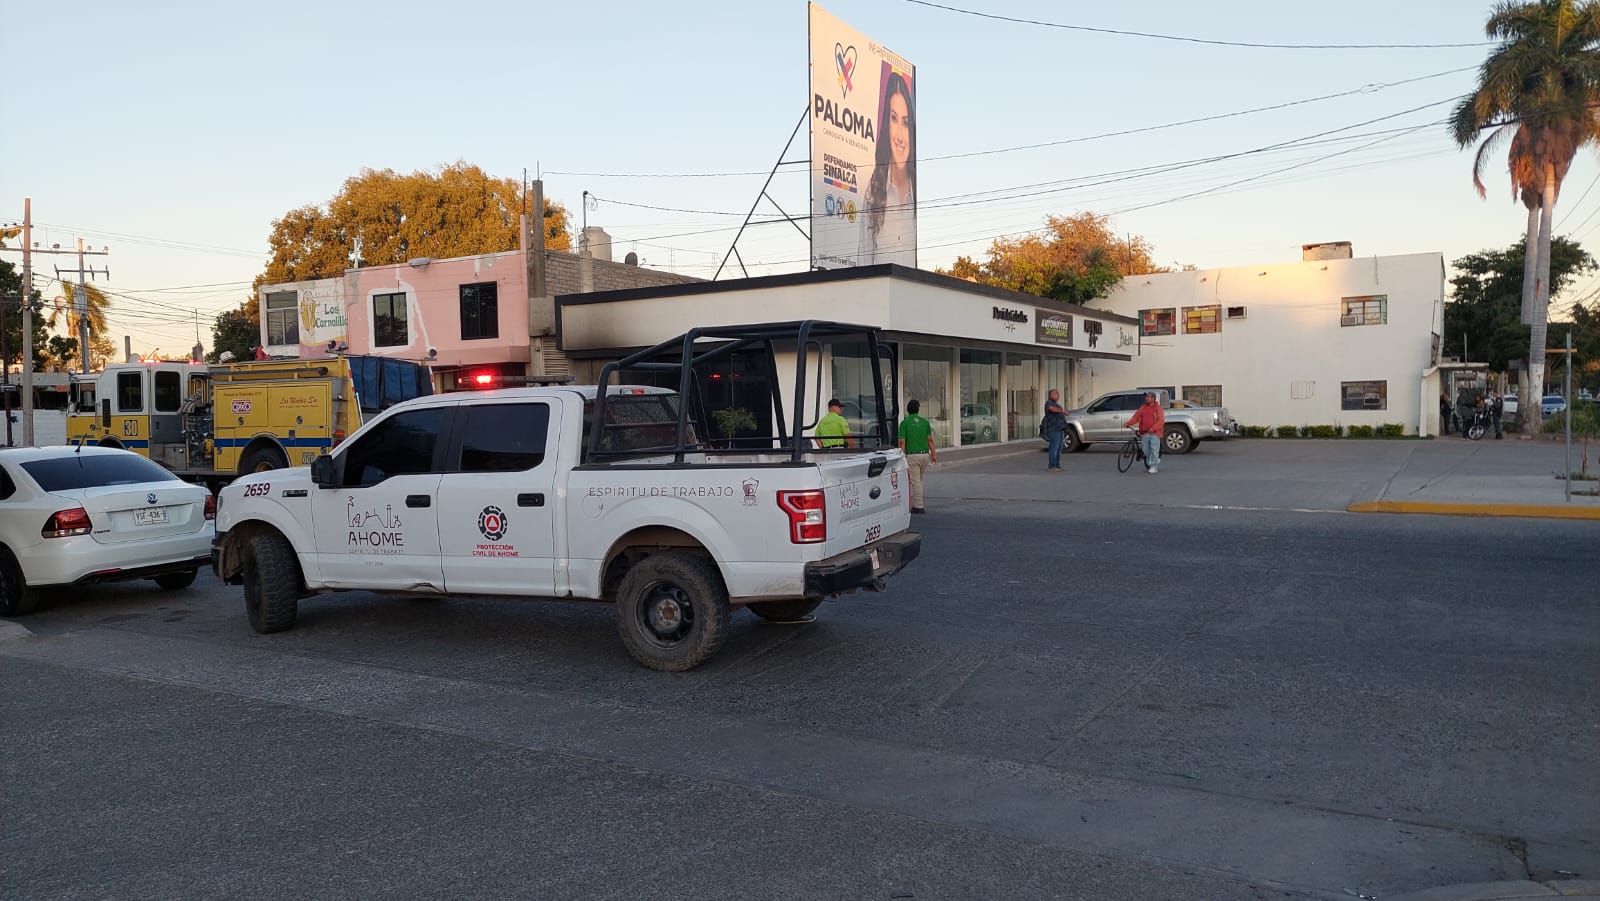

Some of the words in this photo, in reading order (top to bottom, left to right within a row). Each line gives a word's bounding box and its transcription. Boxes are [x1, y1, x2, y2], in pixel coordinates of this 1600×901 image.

[815, 92, 875, 143] PALOMA
[824, 152, 857, 173] DEFENDAMOS
[324, 304, 340, 315] Los
[125, 420, 138, 436] 30
[244, 482, 271, 497] 2659
[589, 485, 646, 498] ESPÍRITU
[650, 486, 668, 497] DE
[672, 486, 734, 498] TRABAJO
[348, 531, 404, 547] AHOME
[864, 524, 881, 543] 2659
